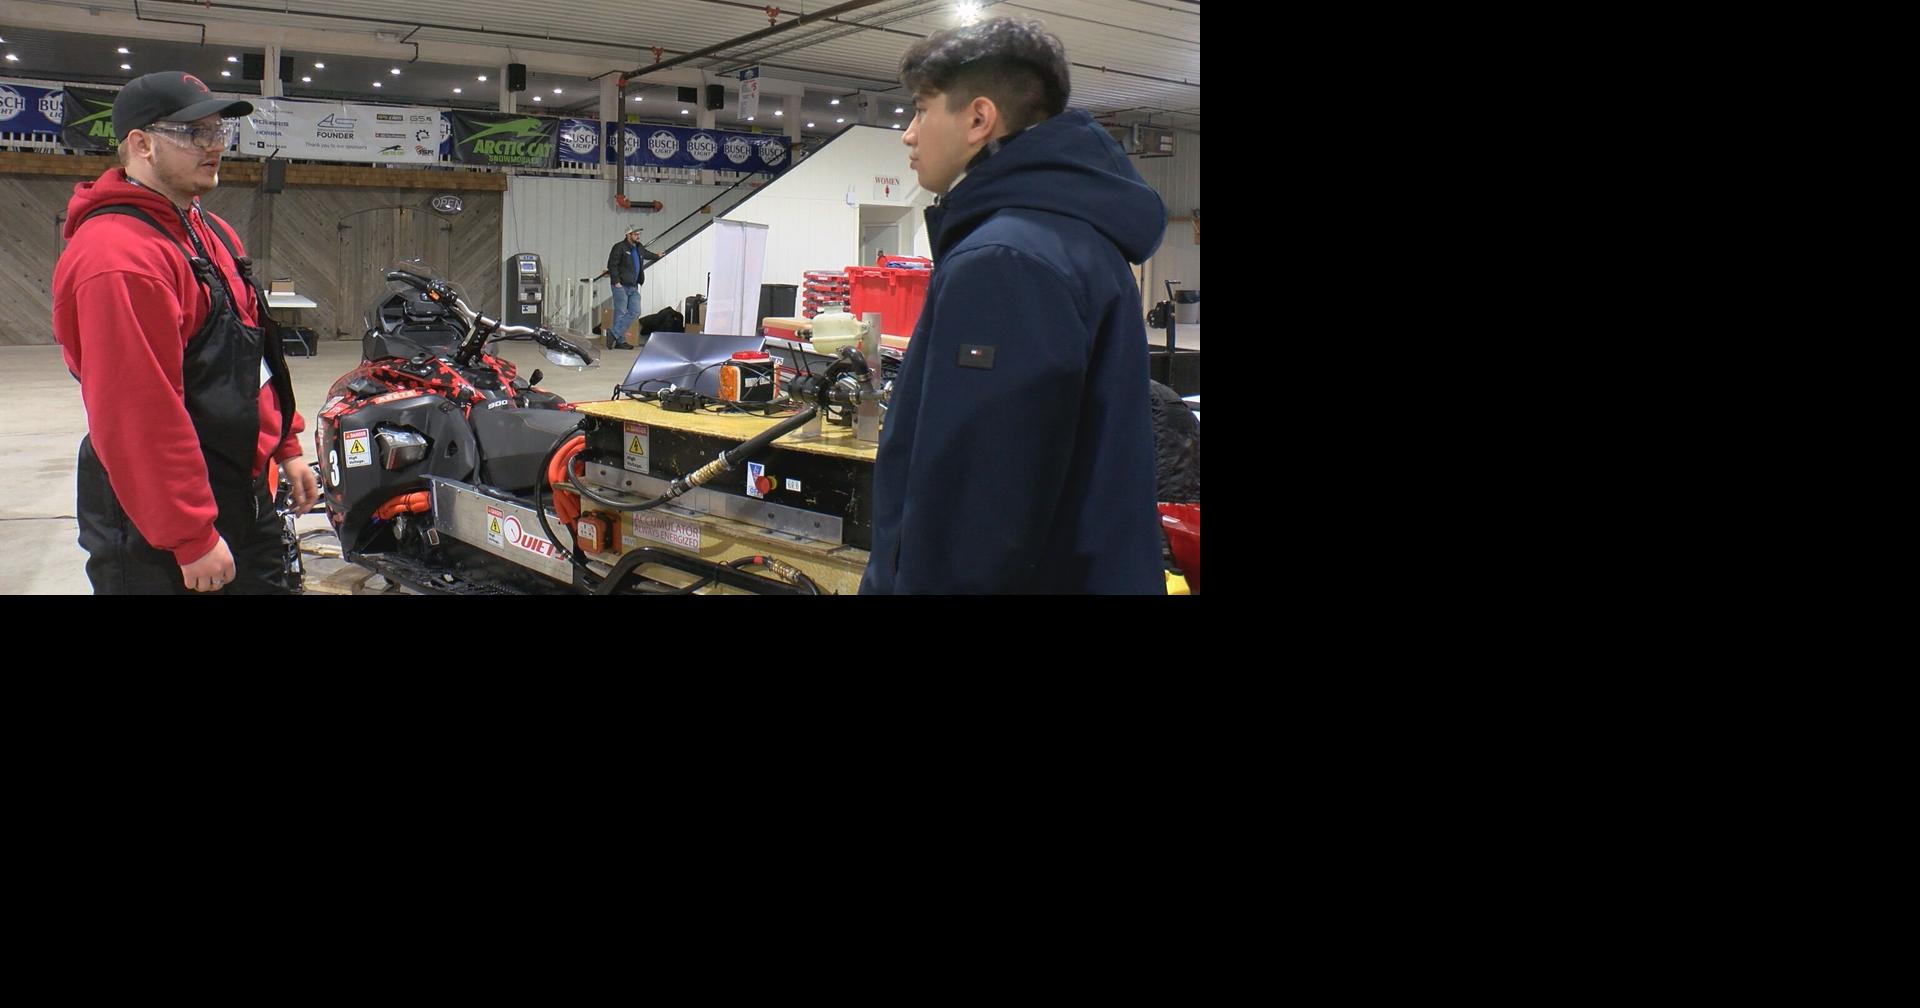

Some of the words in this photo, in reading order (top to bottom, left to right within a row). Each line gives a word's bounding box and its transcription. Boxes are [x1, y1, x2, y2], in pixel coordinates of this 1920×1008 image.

[0, 96, 24, 109] SCH
[39, 98, 63, 111] BUS
[316, 131, 354, 140] FOUNDER
[564, 133, 599, 145] BUSCH
[609, 136, 640, 148] BSCH
[648, 139, 679, 149] BUSCH
[687, 141, 718, 151] BUSCH
[473, 139, 528, 156] ARCTIC
[527, 143, 554, 158] CAT
[724, 144, 752, 154] BUSCH
[874, 176, 900, 185] WOMEN
[432, 196, 463, 211] OPEN
[329, 449, 340, 487] 3
[634, 513, 699, 539] ACCUMULATOR
[635, 524, 660, 538] ALWAYS
[660, 530, 699, 549] ENERGIZED
